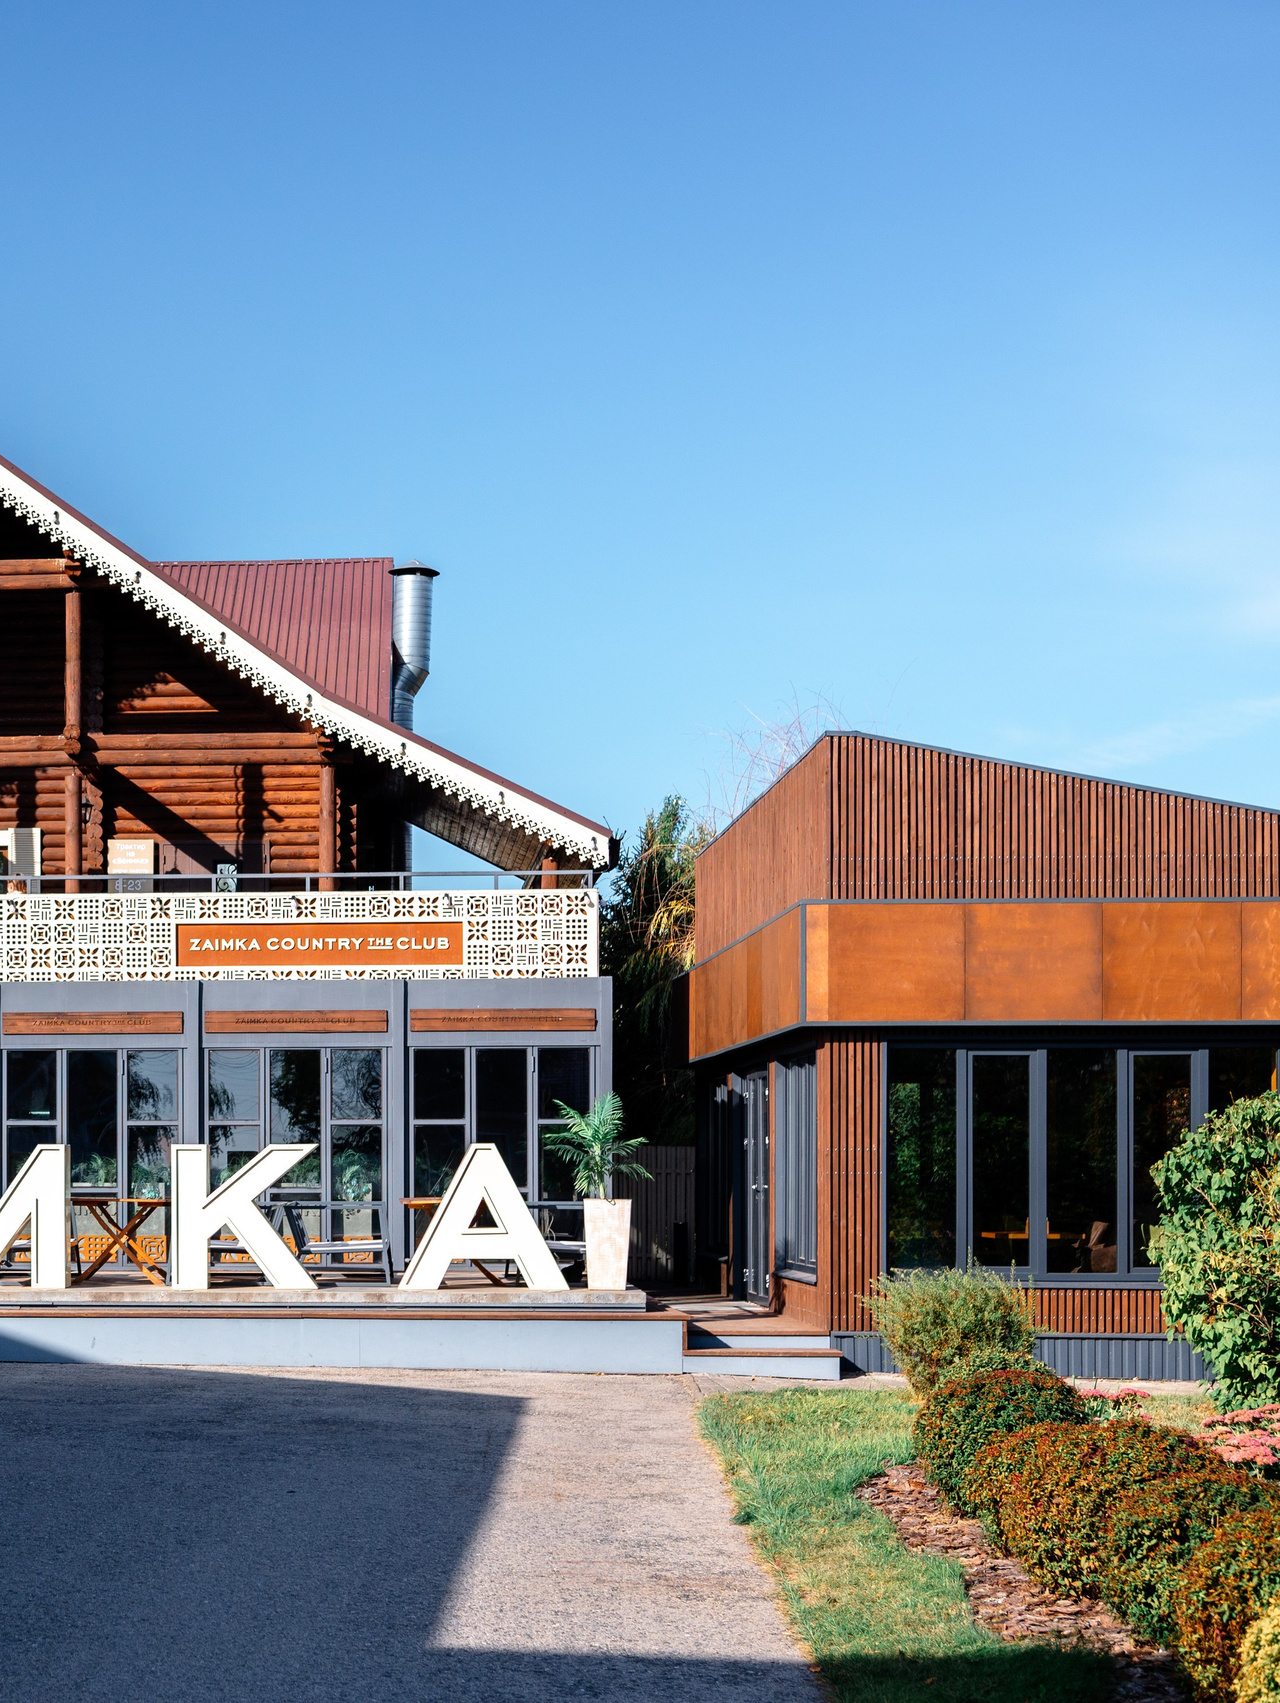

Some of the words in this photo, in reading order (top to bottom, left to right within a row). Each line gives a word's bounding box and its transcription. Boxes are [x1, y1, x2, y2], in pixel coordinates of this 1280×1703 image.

[189, 938, 261, 951] ZAIMKA
[266, 937, 364, 951] COUNTRY
[367, 937, 394, 949] THE
[396, 937, 450, 950] CLUB
